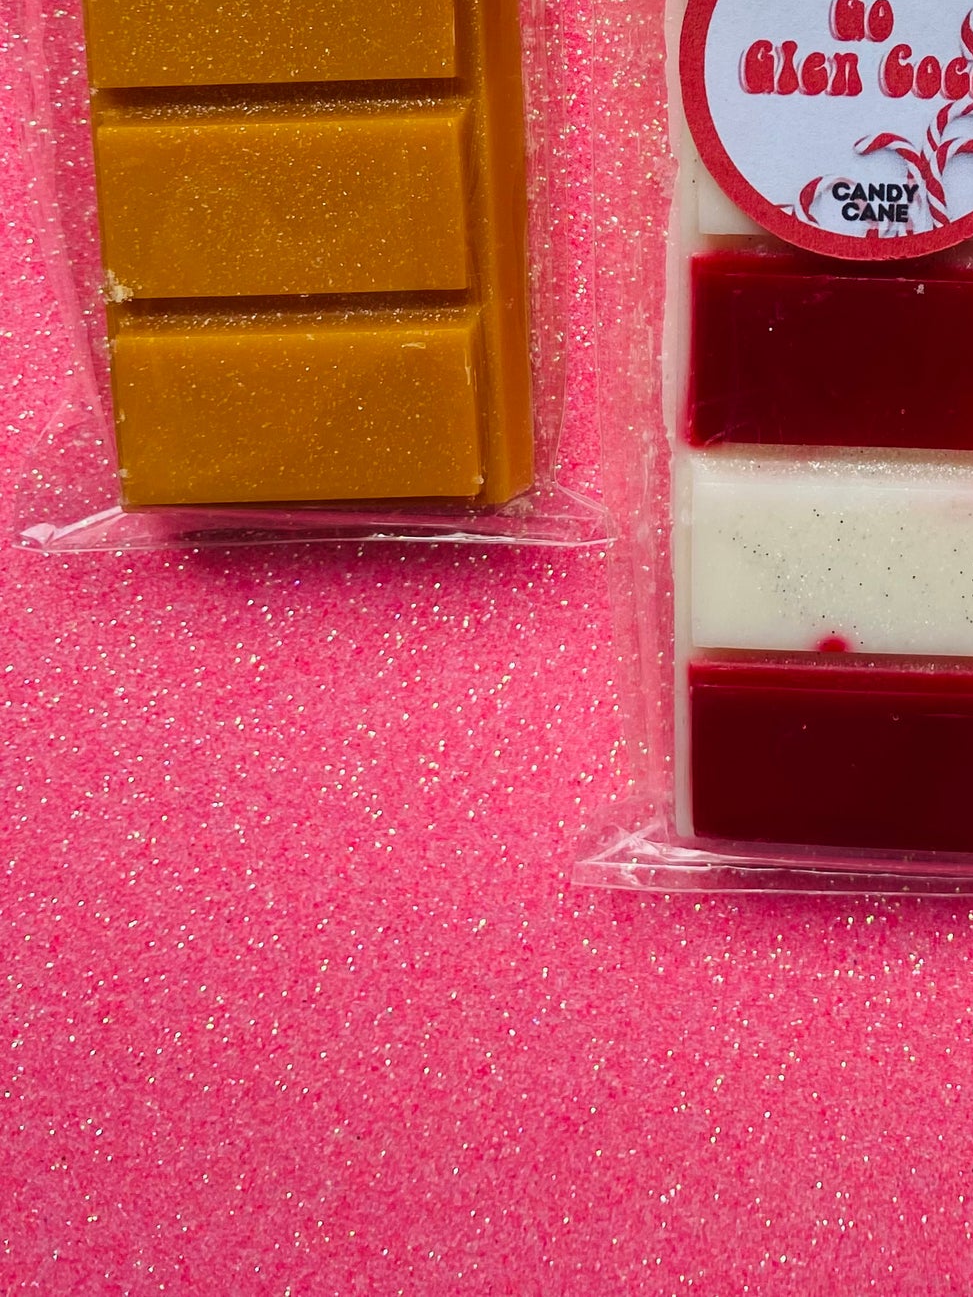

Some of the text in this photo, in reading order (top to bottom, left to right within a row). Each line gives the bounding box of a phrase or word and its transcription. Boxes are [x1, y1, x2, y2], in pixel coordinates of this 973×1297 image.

[739, 39, 863, 97] Glen
[831, 181, 920, 203] CANDY
[841, 202, 910, 223] CANE
